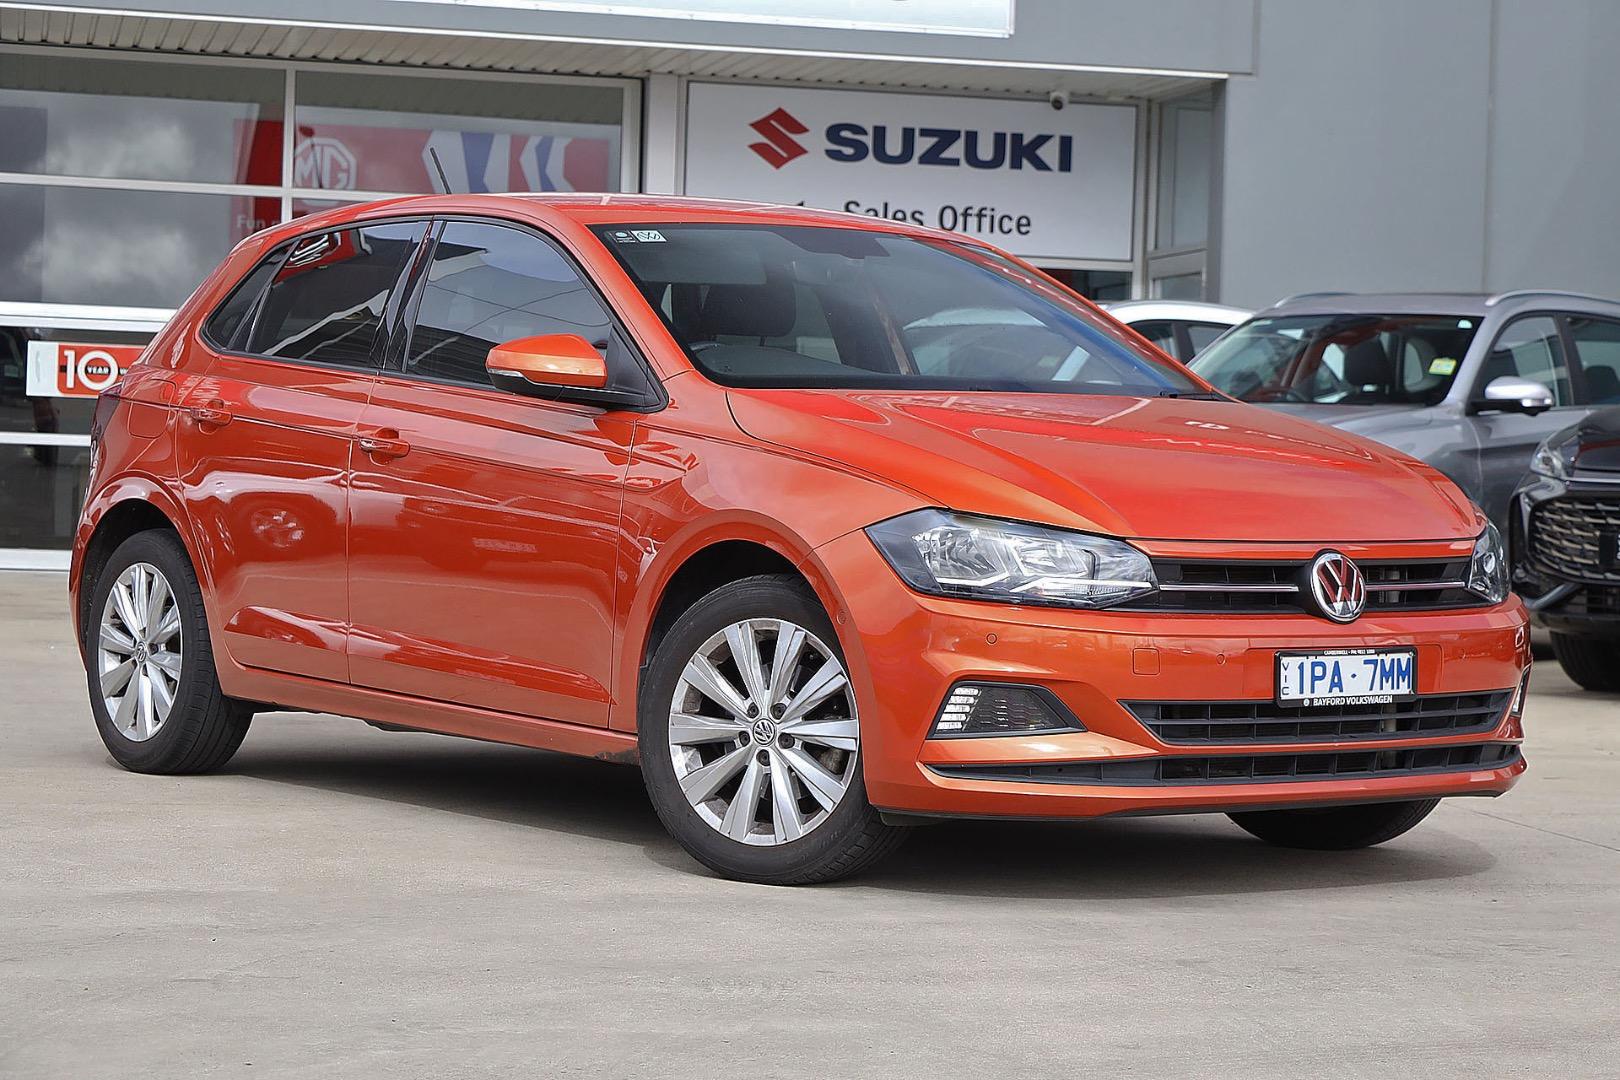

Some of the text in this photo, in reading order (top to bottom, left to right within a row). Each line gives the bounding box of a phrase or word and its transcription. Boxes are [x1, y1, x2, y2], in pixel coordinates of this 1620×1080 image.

[823, 121, 1074, 173] SUZUKI
[294, 143, 352, 190] MG
[938, 204, 1032, 236] Office
[63, 349, 119, 391] 10 YEAR
[1281, 661, 1290, 696] VIC
[1312, 694, 1393, 706] BAYFORD VOLKSWAGEN
